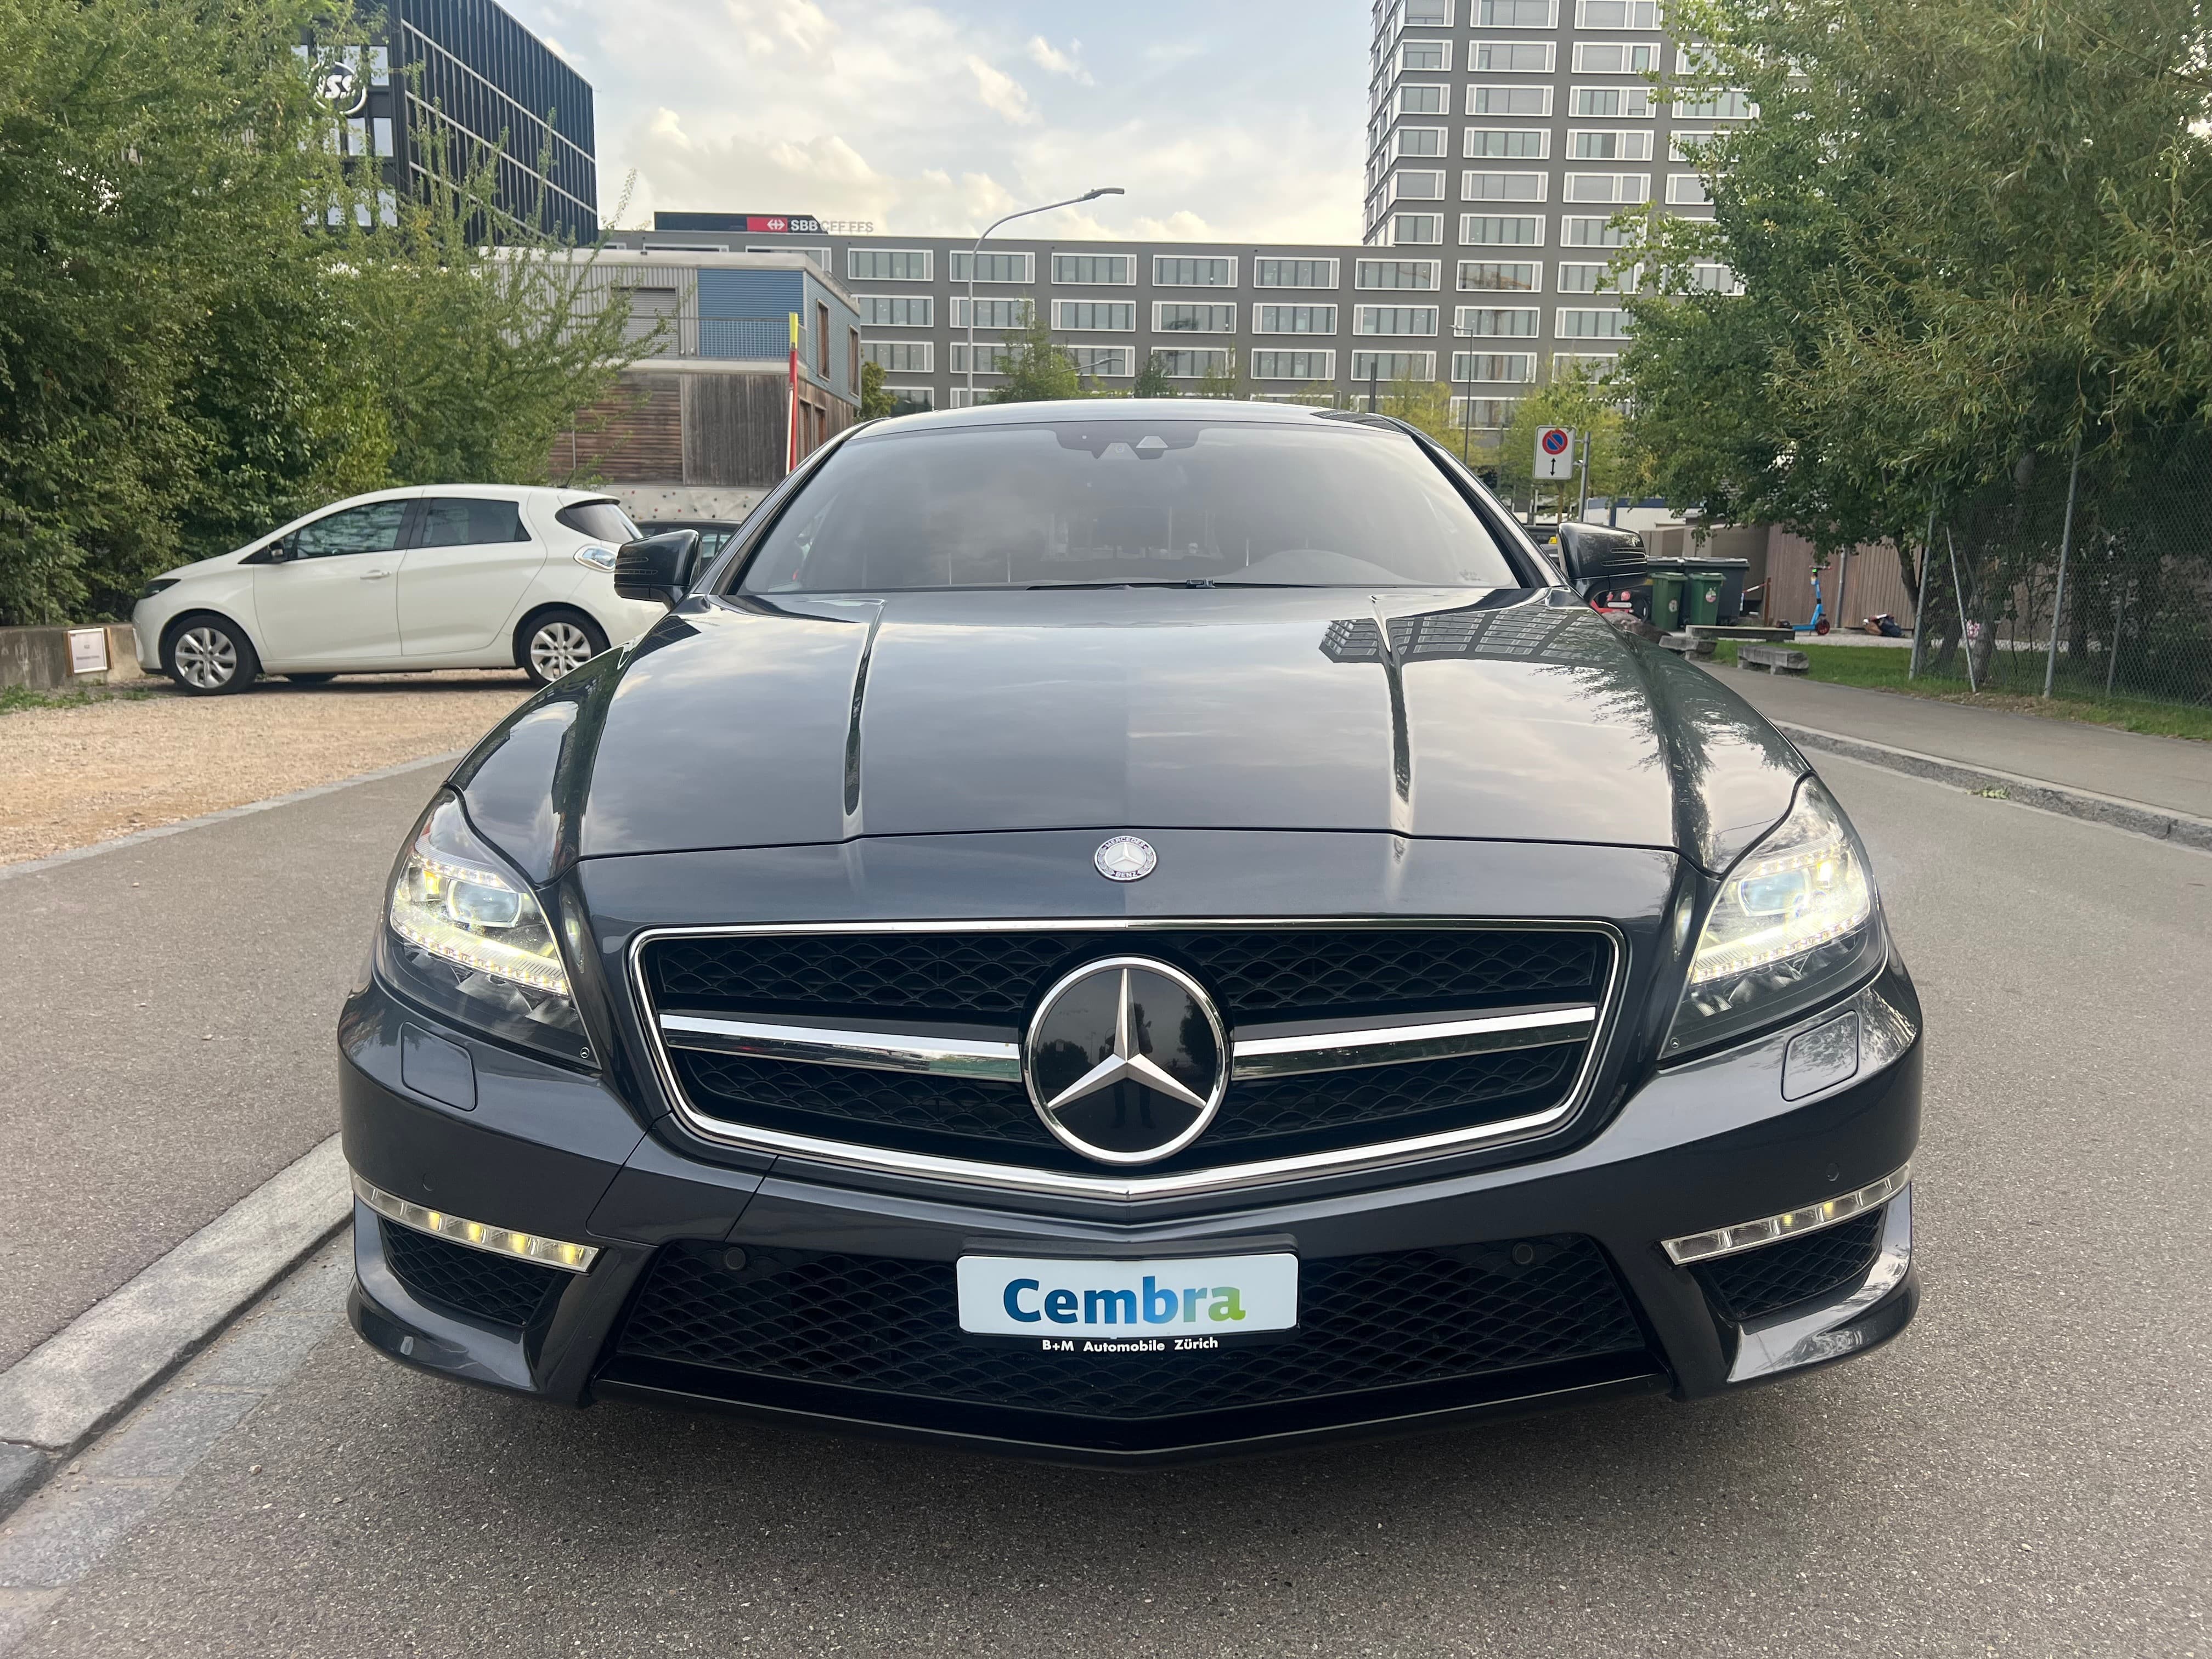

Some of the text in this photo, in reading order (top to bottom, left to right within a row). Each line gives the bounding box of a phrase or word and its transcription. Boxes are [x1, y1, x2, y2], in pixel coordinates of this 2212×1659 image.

[790, 219, 874, 233] SBB CFF FFS
[1105, 837, 1145, 848] MERCEDES
[1003, 1276, 1246, 1324] Cembra
[1042, 1336, 1218, 1352] B+M Automobile Zürich
